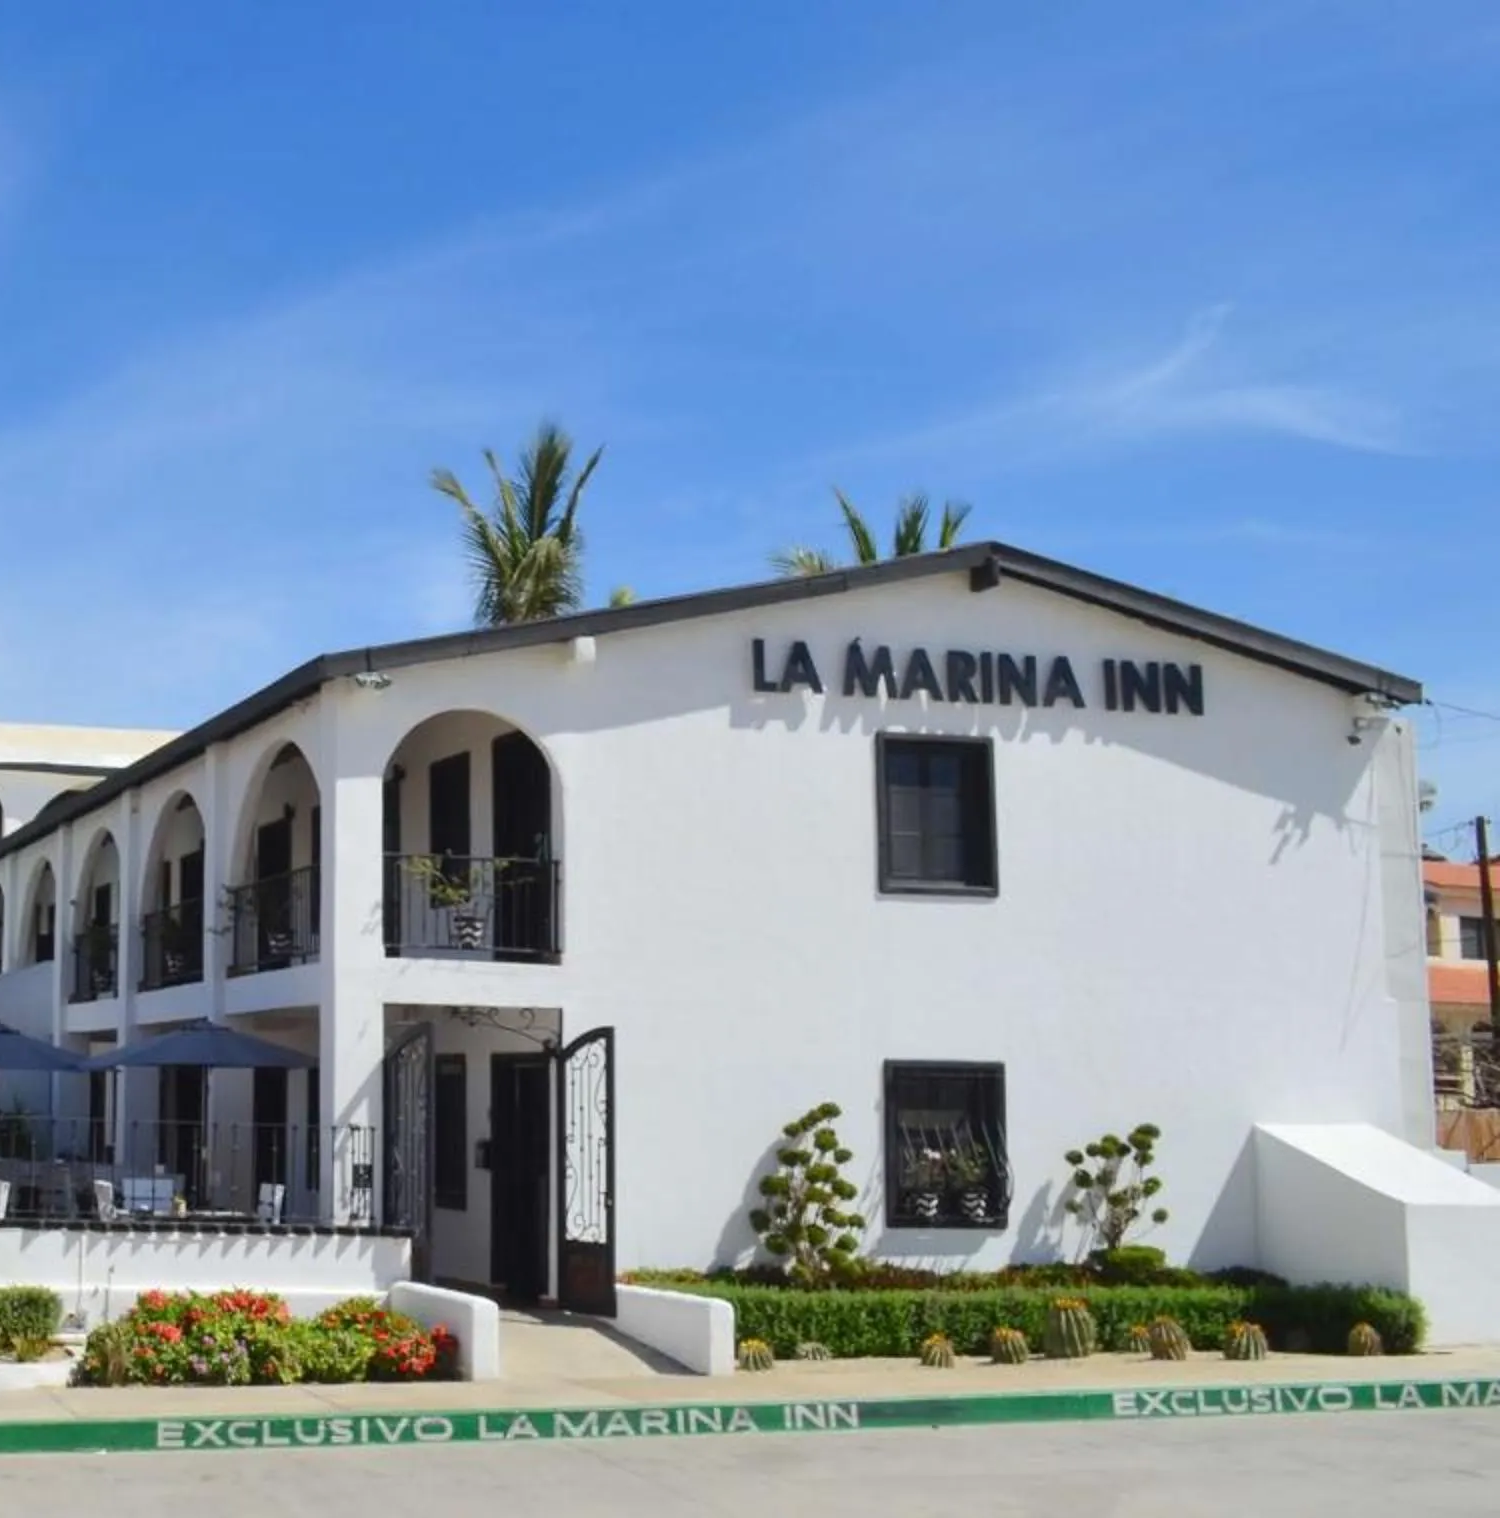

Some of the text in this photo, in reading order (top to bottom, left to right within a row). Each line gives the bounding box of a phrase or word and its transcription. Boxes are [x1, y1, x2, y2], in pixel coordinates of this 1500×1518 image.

[751, 638, 1205, 716] LA MARINA INN
[1112, 1385, 1353, 1417] EXCLUSIVO
[1375, 1383, 1426, 1410] LA
[156, 1403, 859, 1447] EXCLUSIVO LA MARINA INN
